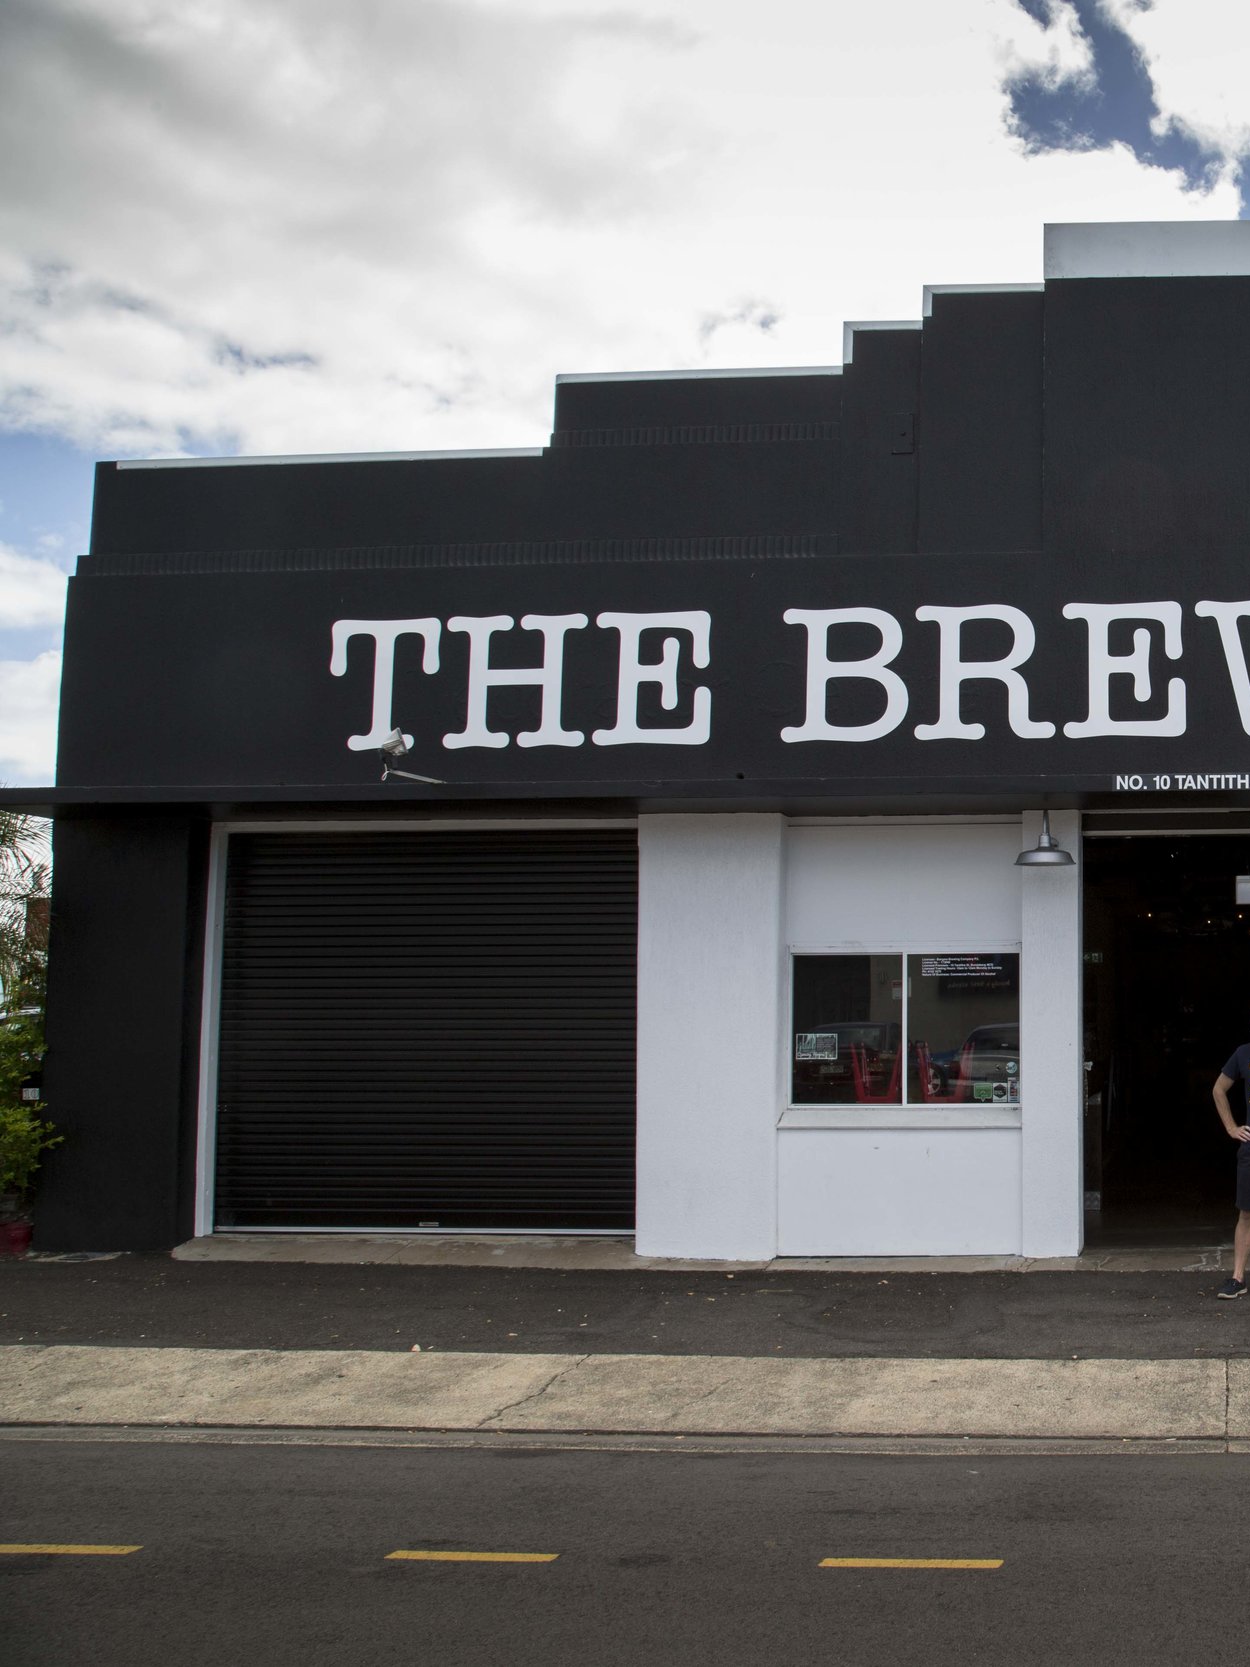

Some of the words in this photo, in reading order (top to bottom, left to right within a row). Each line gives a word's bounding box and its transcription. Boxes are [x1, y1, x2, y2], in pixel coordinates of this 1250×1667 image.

[329, 610, 712, 752] THE
[1116, 774, 1149, 791] NO.
[1152, 774, 1172, 791] 10
